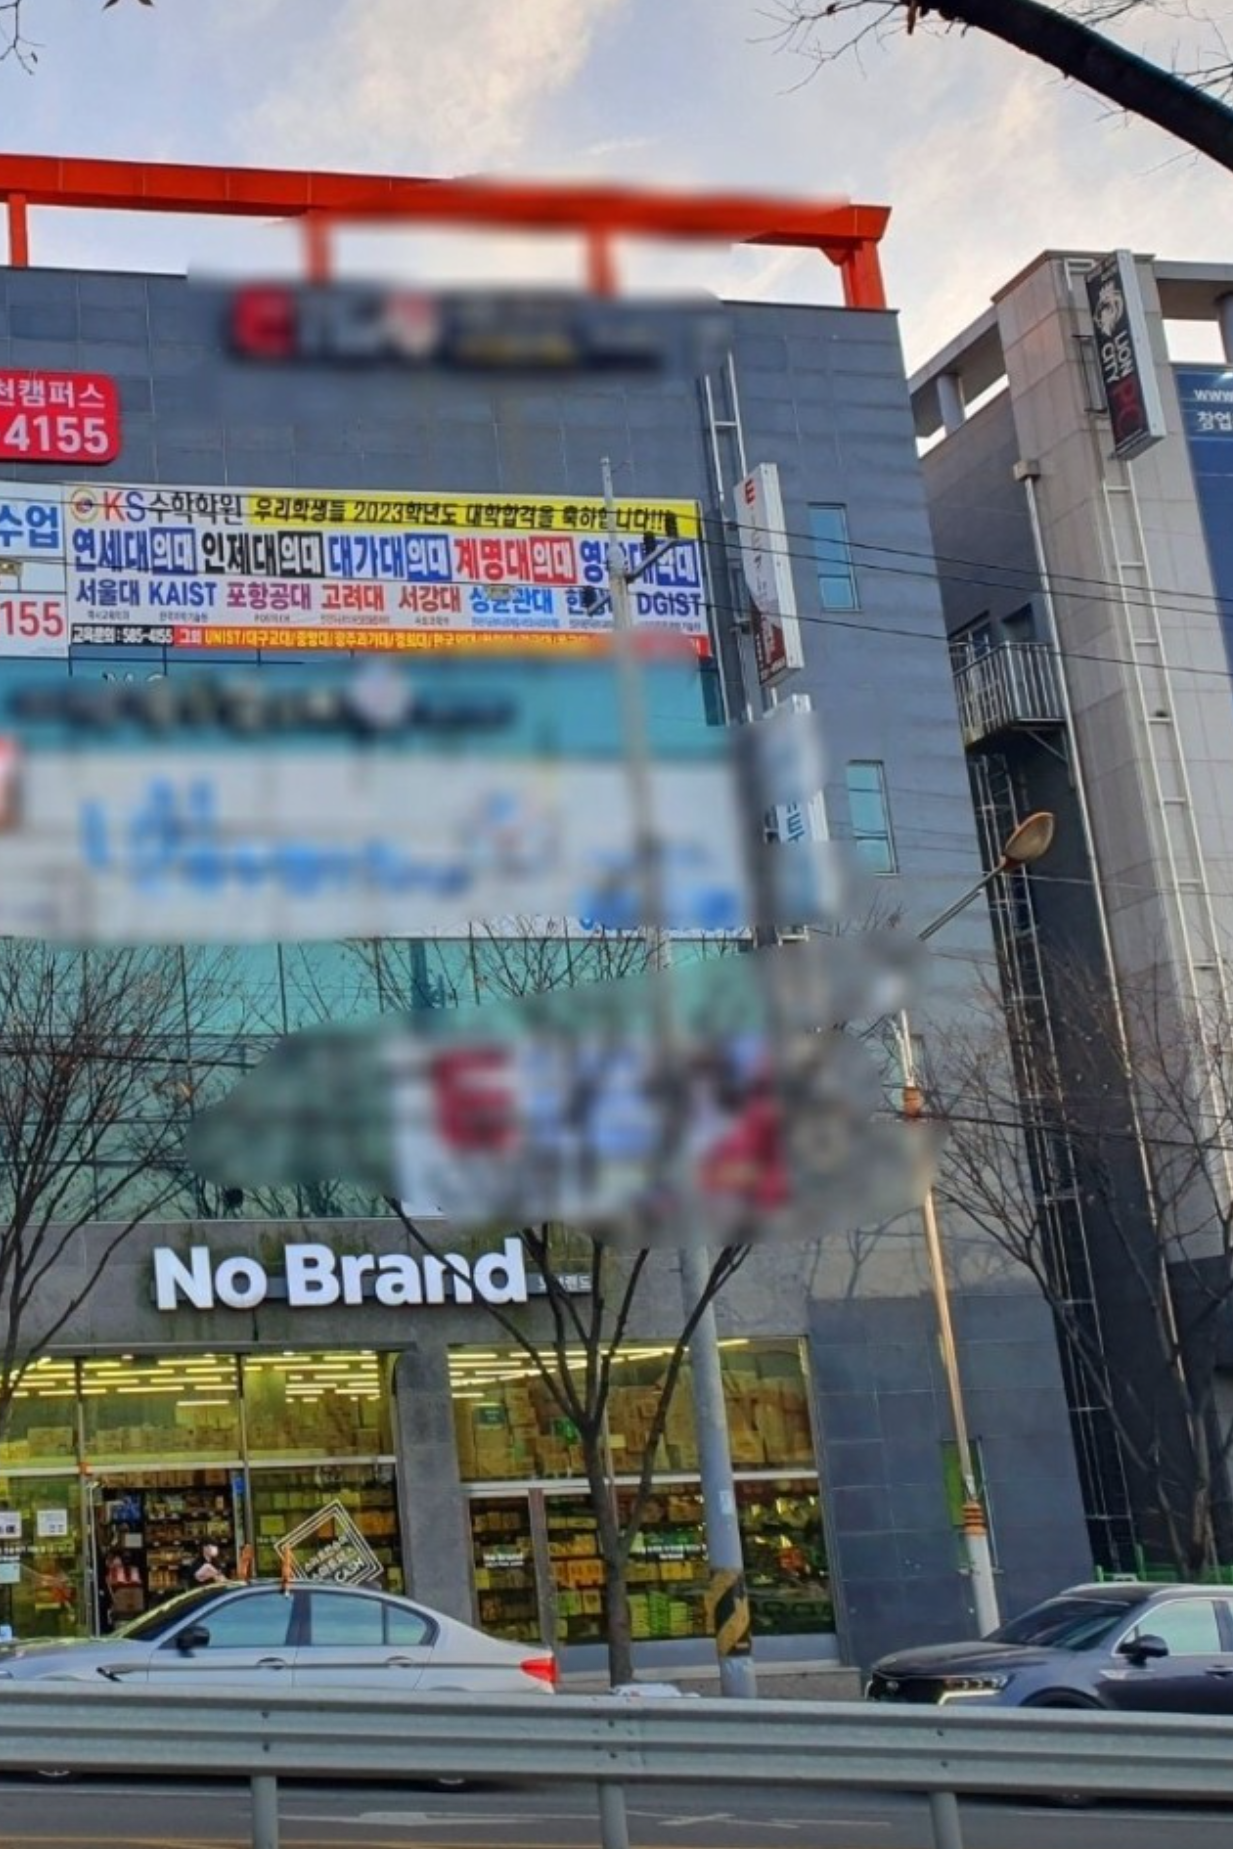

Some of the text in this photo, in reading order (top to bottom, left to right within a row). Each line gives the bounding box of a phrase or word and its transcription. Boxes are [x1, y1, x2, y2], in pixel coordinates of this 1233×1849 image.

[77, 579, 140, 607] 서울대
[149, 581, 217, 608] KAIST
[227, 583, 311, 610] 포항공대
[321, 584, 385, 612] 고려대
[399, 585, 461, 613] 서강대
[637, 593, 701, 617] DGIST
[153, 1236, 529, 1311] No Brand
